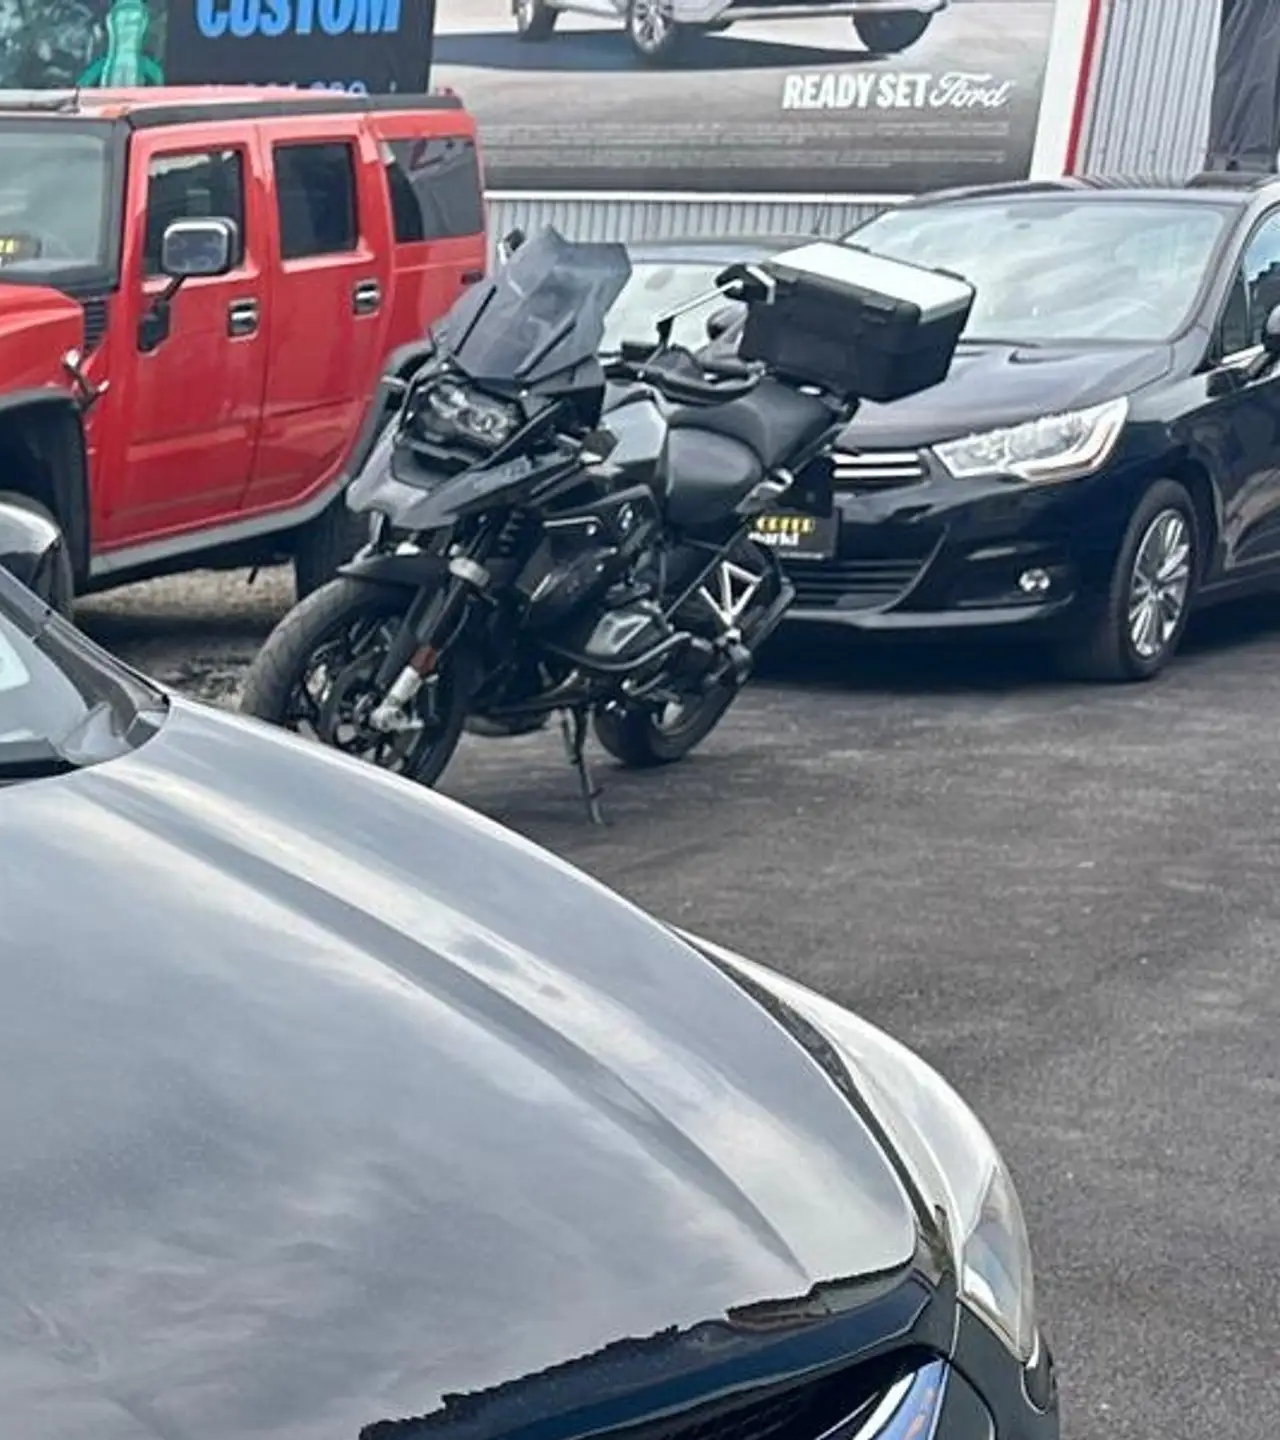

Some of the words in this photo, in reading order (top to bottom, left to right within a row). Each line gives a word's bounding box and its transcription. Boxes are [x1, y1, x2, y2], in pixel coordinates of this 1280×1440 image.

[196, 0, 402, 38] CUSTOM
[782, 72, 877, 110] READY
[876, 72, 933, 109] SET
[929, 71, 1011, 109] Ford
